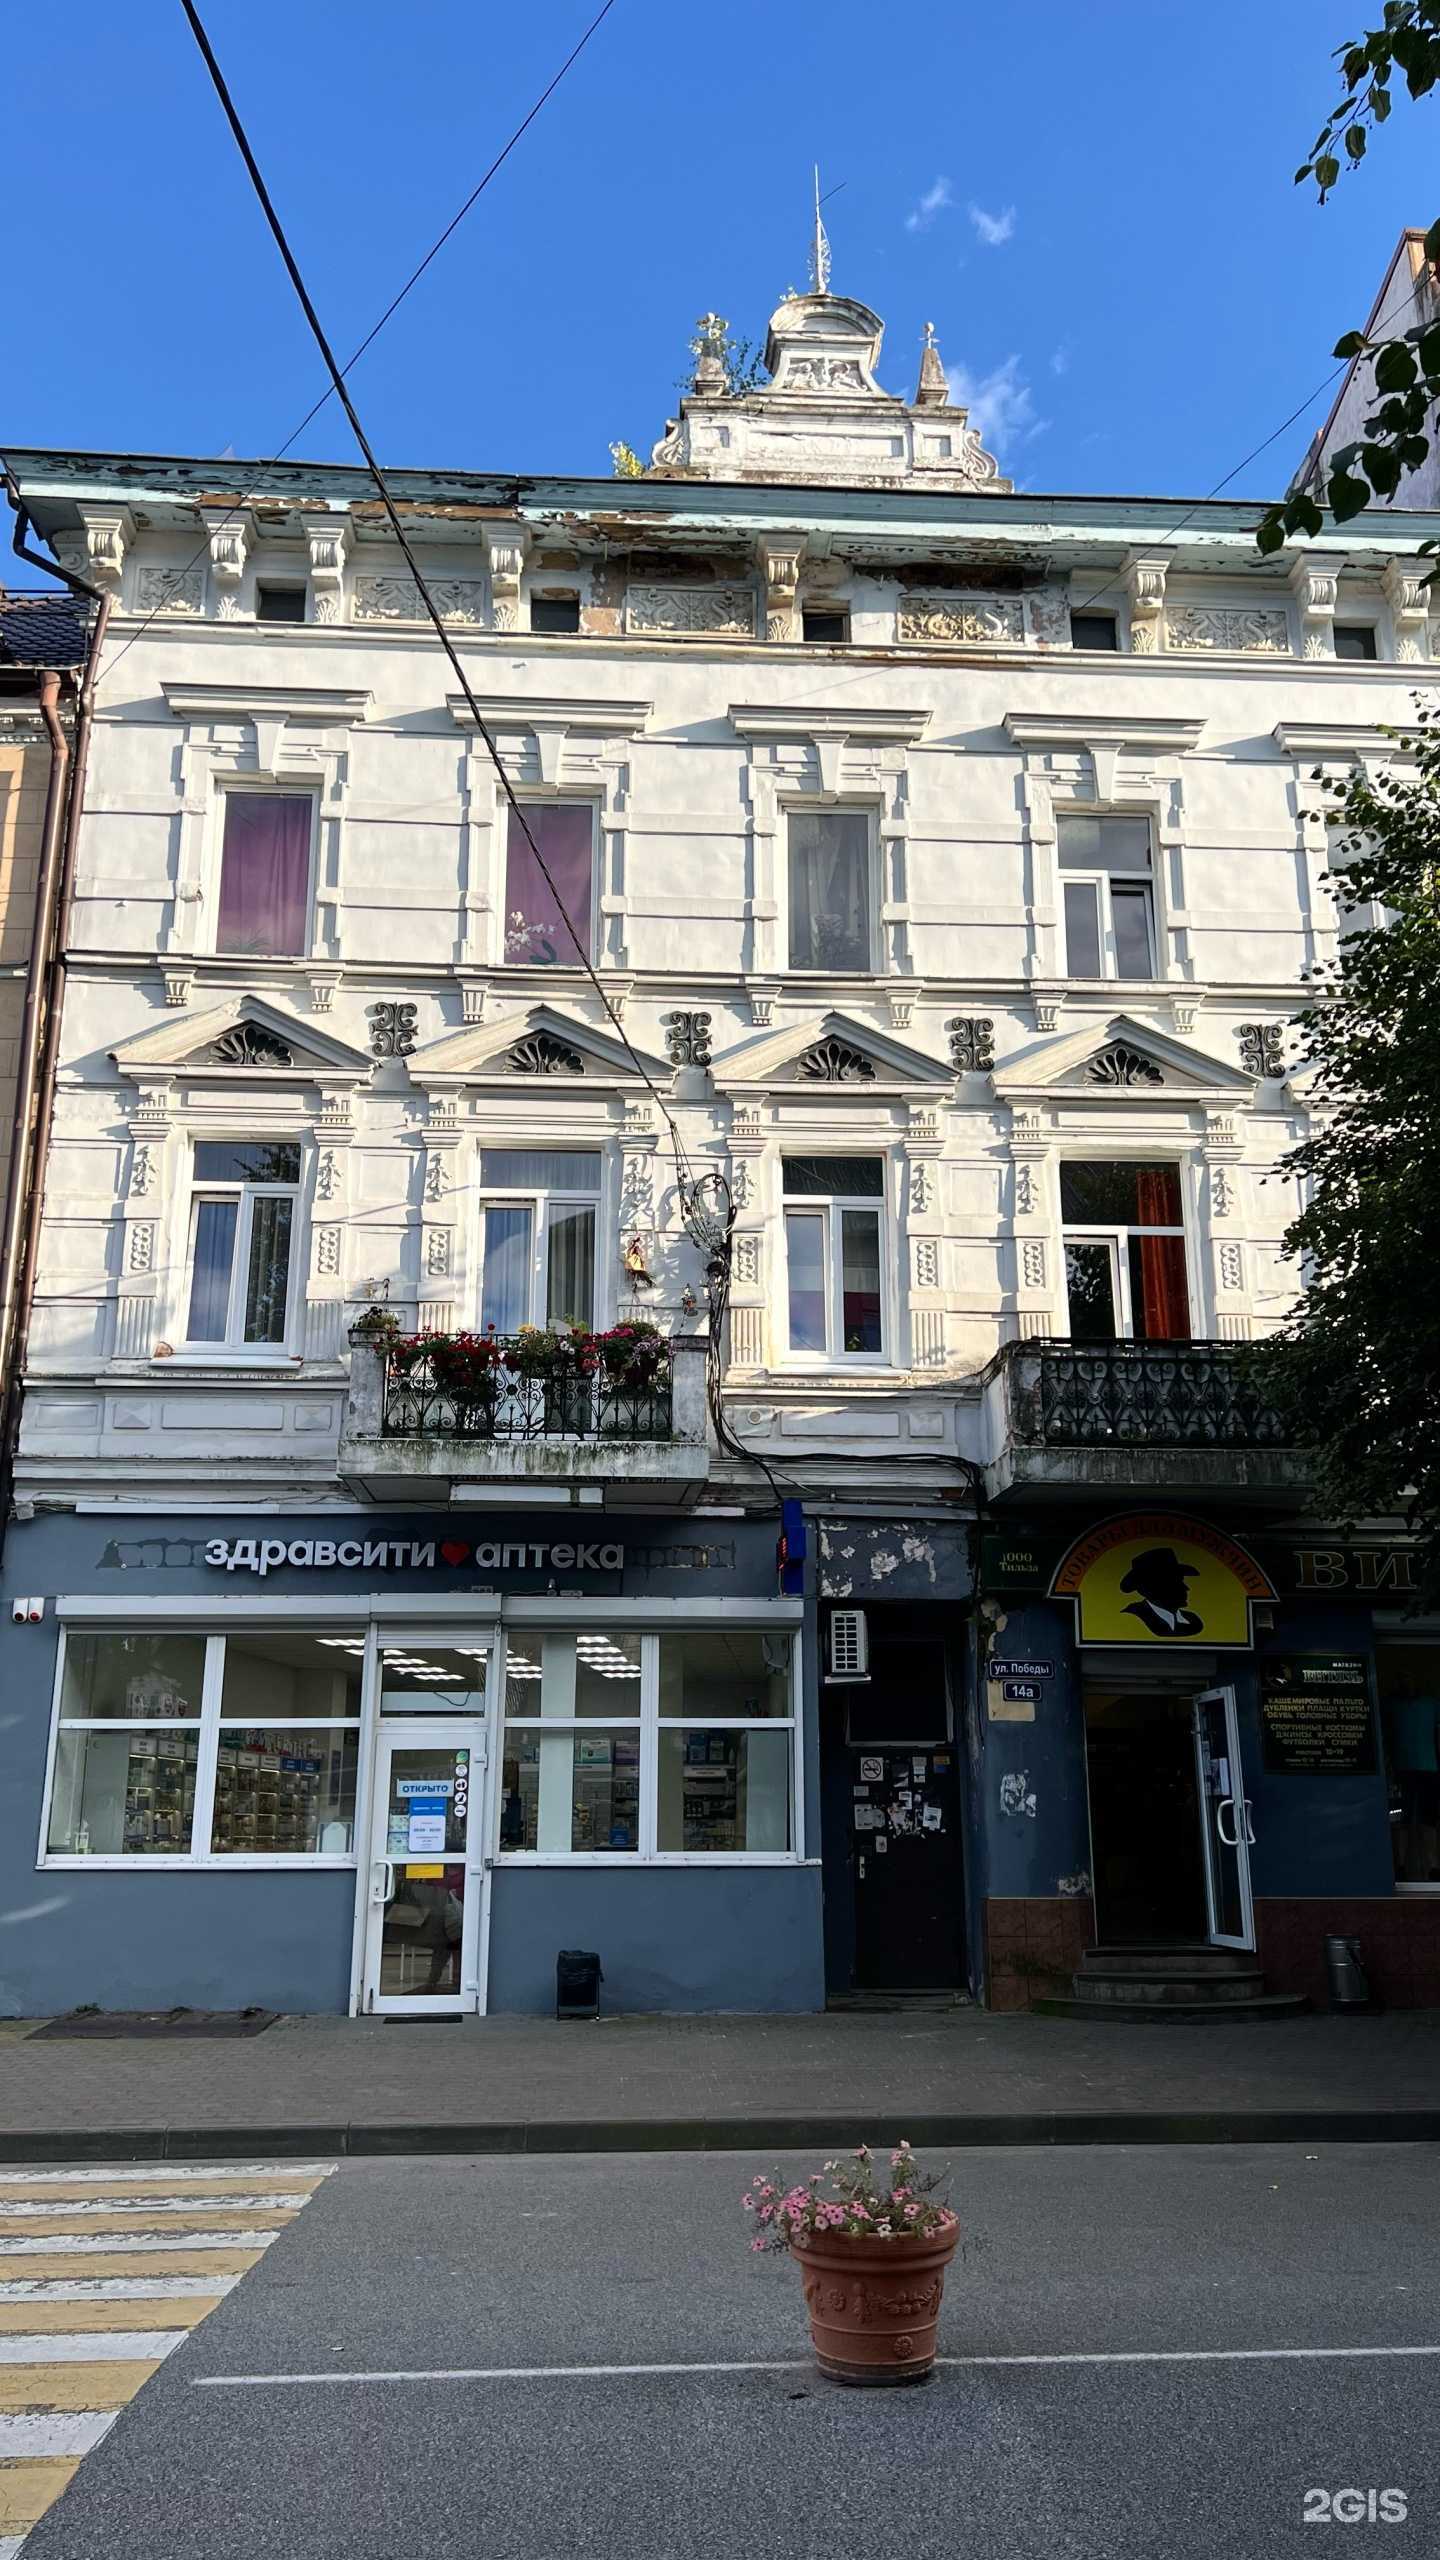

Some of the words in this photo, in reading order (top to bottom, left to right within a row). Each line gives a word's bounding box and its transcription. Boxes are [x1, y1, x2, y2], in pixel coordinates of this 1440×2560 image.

[205, 1538, 436, 1576] здравсити
[475, 1542, 624, 1569] аптека
[1062, 1525, 1128, 1588] ТОВАРЫ
[994, 1664, 1009, 1675] ул.
[1011, 1663, 1050, 1676] Победы
[1012, 1685, 1034, 1698] 14а
[402, 1784, 449, 1793] ОТКРЫТО
